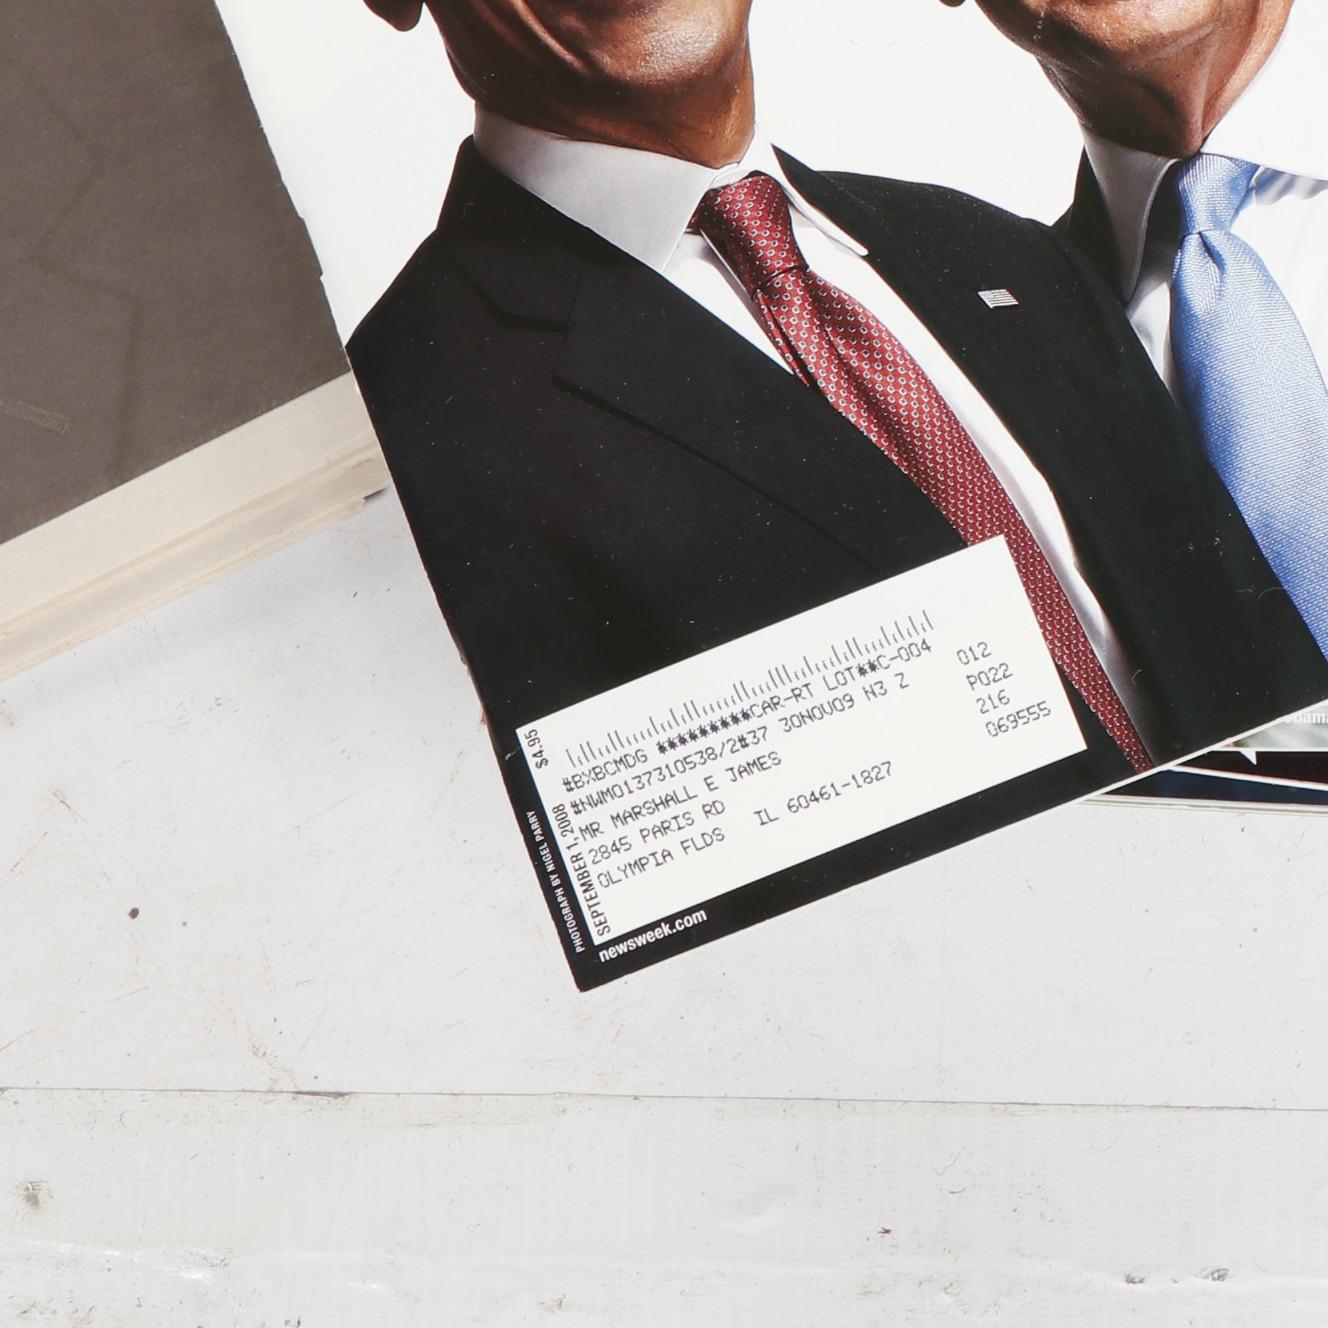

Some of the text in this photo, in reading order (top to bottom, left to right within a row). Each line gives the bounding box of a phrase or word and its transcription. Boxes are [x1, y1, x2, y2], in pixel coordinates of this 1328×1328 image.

[957, 641, 992, 666] 012
[966, 663, 1014, 691] P022
[975, 689, 1011, 715] 216
[985, 700, 1051, 738] 069555
[524, 729, 549, 769] $4.95
[578, 750, 783, 843] MR MARSHALL E JAMES
[588, 799, 726, 866] 2845 PARIS RD
[596, 761, 895, 889] OLYMPIA FLDS IL 60461-1827
[526, 810, 586, 953] PHOTOGRAPH NIGEL PARRY
[552, 803, 611, 937] SEPTEMBER 2008
[599, 908, 708, 962] newsweek.com
